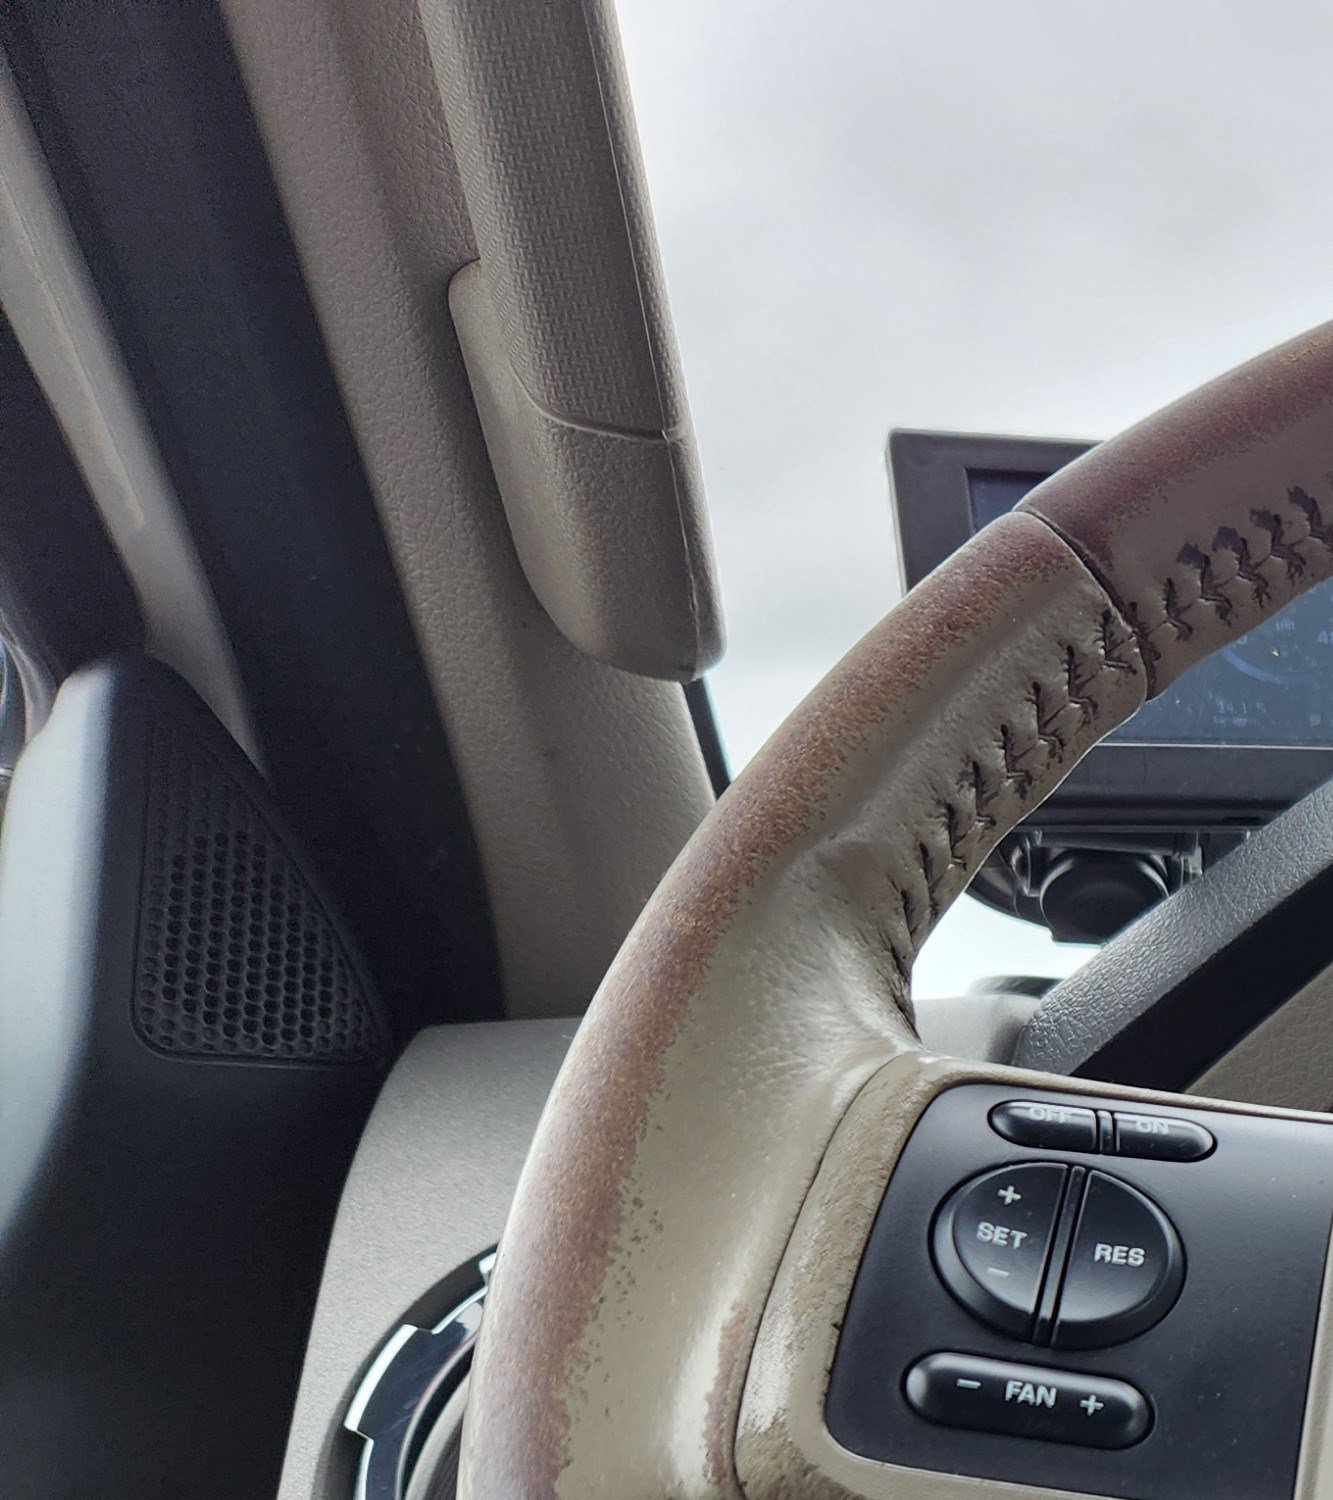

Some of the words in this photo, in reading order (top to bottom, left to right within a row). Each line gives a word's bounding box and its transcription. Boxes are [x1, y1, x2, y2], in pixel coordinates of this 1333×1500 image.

[1028, 1107, 1069, 1122] OFF
[1135, 1120, 1167, 1133] ON
[976, 1222, 1026, 1249] SET
[1094, 1243, 1143, 1267] RES
[1005, 1381, 1055, 1407] FAN
